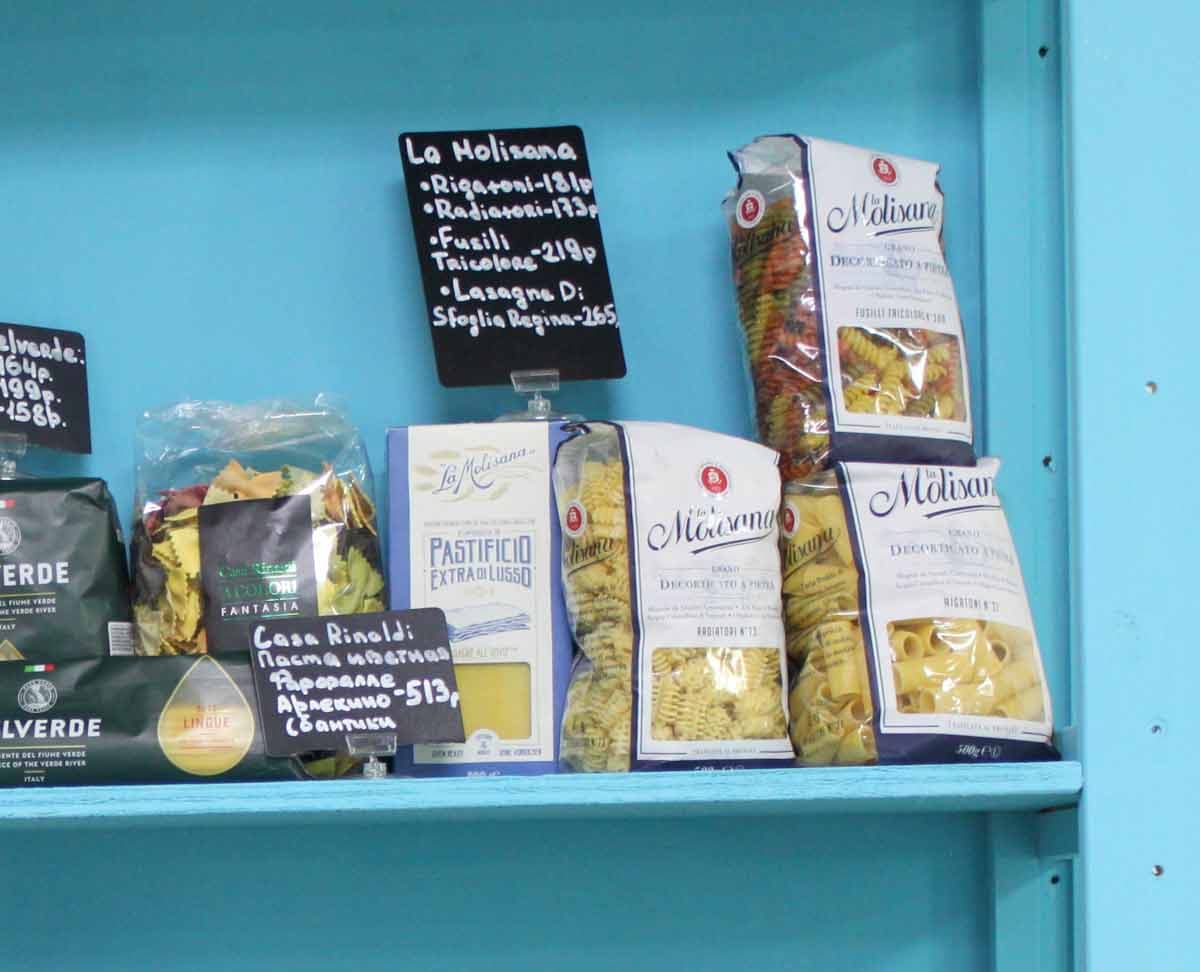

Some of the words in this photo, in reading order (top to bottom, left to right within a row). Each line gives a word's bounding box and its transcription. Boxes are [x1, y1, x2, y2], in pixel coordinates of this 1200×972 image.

[406, 137, 441, 165] La
[452, 133, 577, 162] Molisana
[559, 280, 584, 302] Di
[432, 305, 506, 337] Sfoglia
[431, 535, 532, 567] PASTIFICIO
[431, 566, 475, 592] EXTRA
[489, 565, 532, 588] LUSSO
[221, 602, 298, 616] FANTASIA
[254, 626, 319, 649] Casa
[327, 619, 414, 645] Rinaldi
[258, 649, 341, 668] Паста
[277, 694, 391, 718] Арлекино
